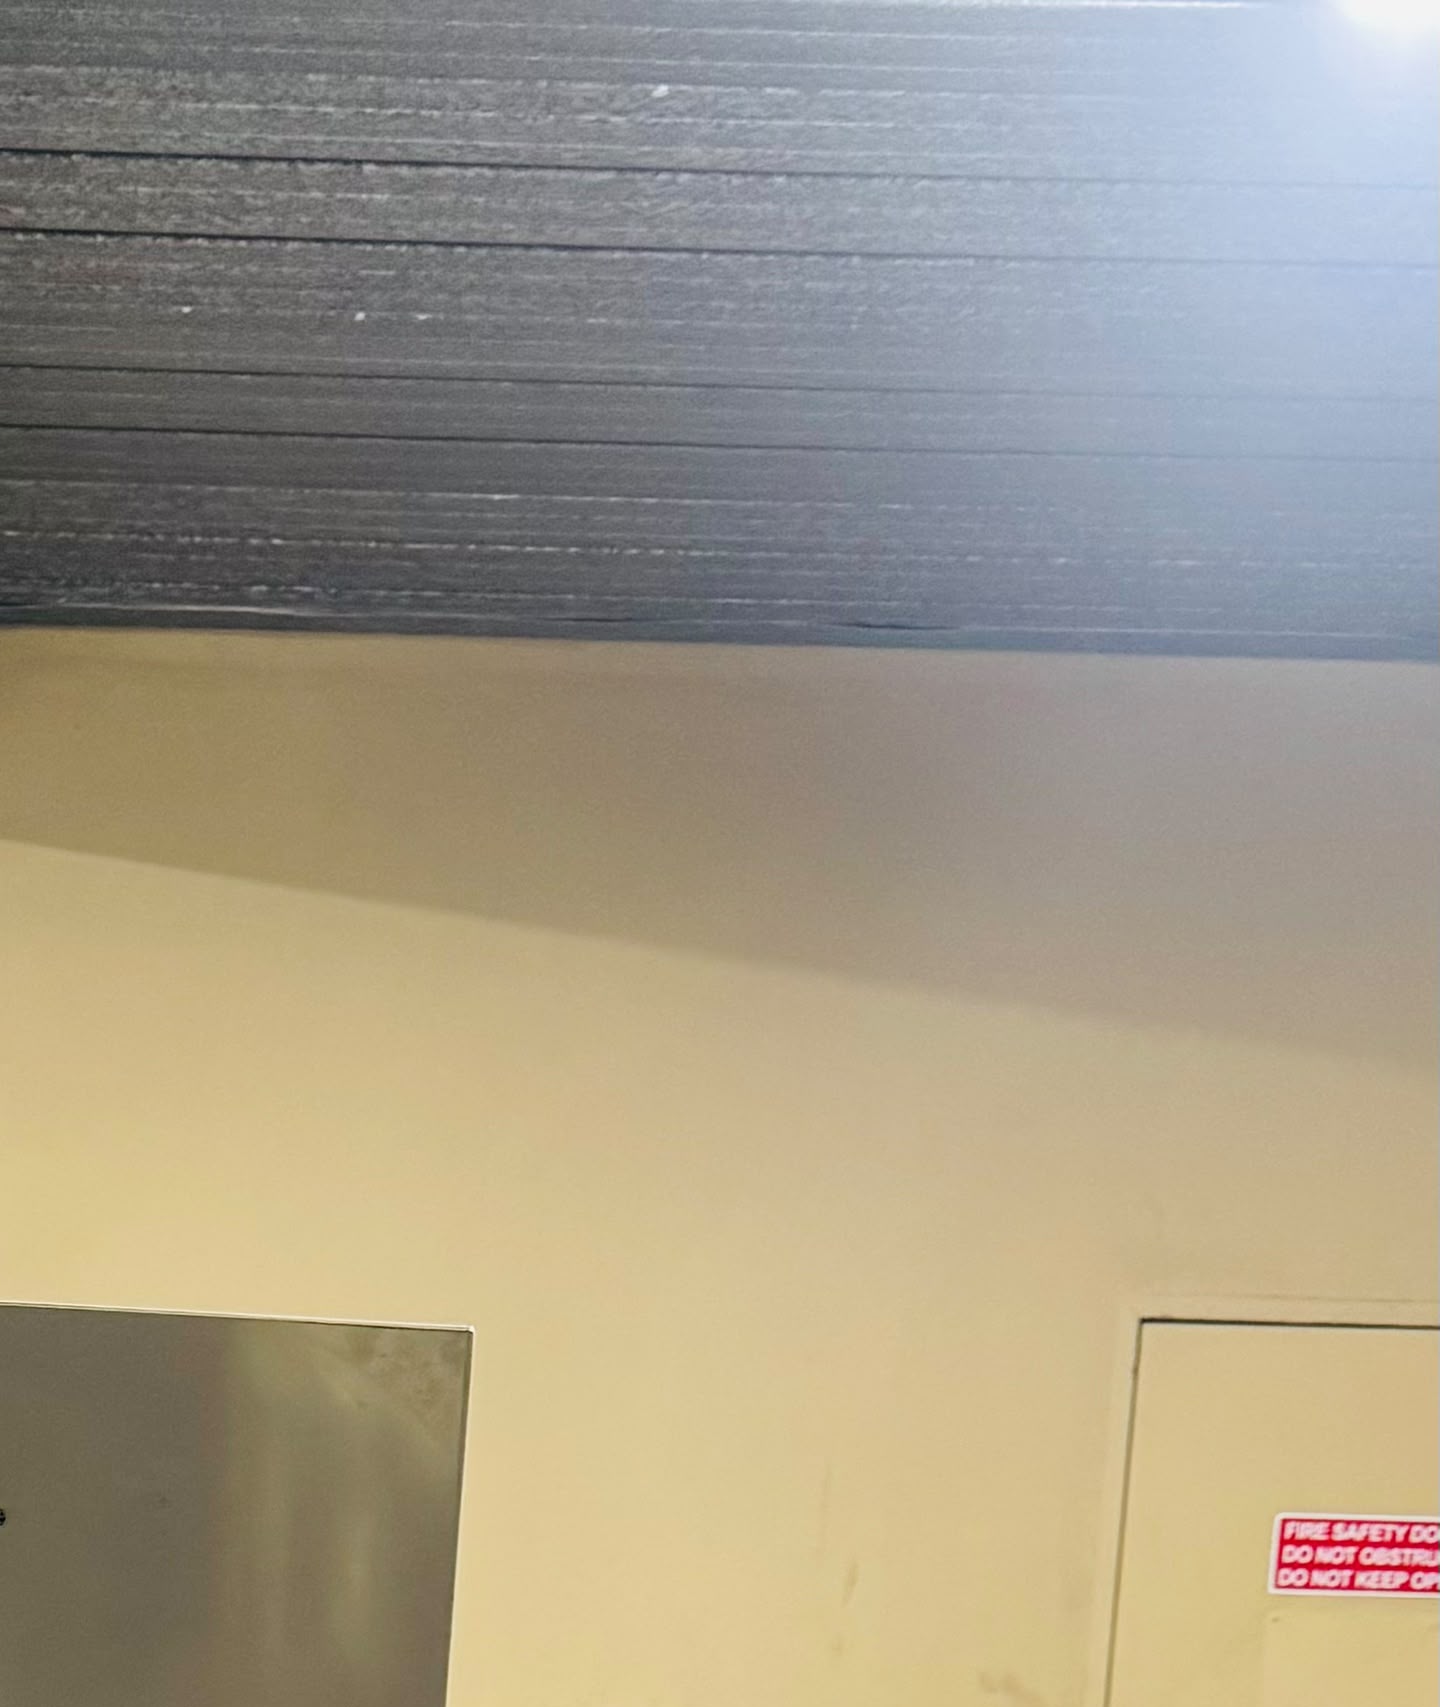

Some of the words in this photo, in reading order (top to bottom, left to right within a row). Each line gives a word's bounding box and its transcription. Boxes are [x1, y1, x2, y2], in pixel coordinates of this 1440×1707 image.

[1283, 1521, 1331, 1541] FIRE
[1331, 1523, 1410, 1543] SAFETY
[1281, 1544, 1313, 1564] DO
[1314, 1546, 1359, 1565] NOT
[1277, 1568, 1309, 1587] DO
[1310, 1569, 1354, 1588] NOT
[1354, 1571, 1410, 1589] KEEP
[1410, 1571, 1440, 1590] OP
